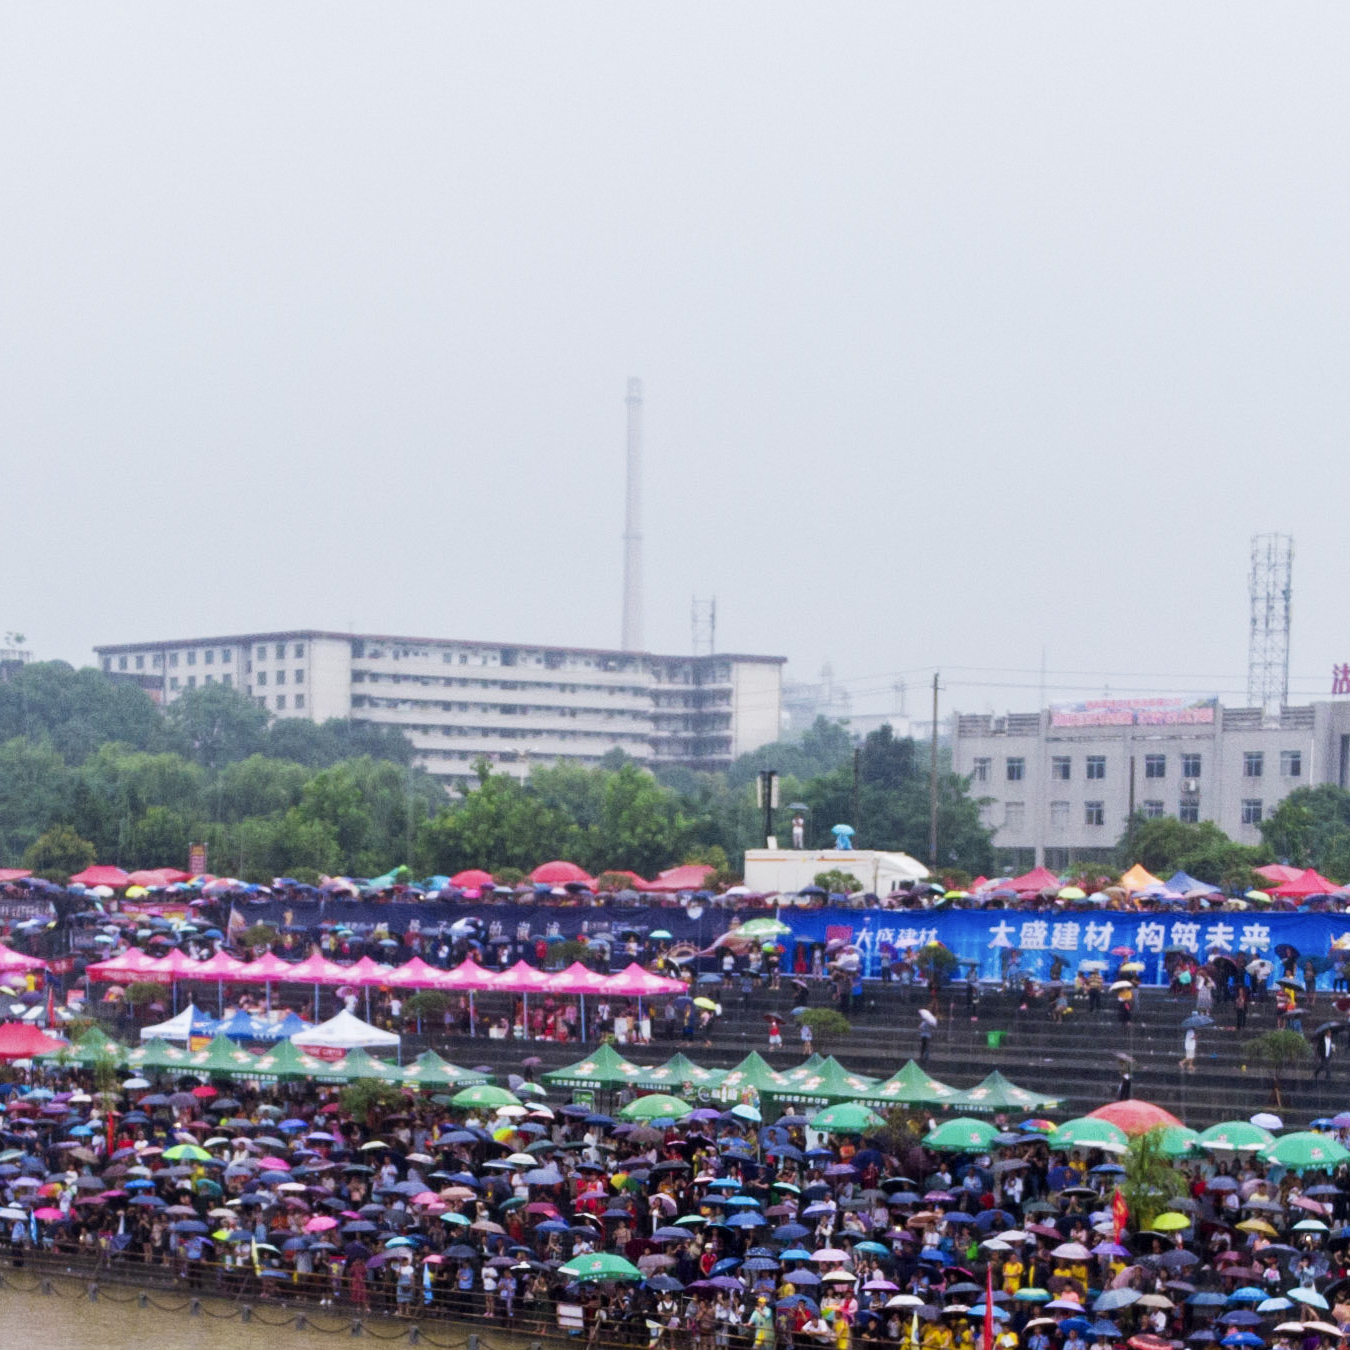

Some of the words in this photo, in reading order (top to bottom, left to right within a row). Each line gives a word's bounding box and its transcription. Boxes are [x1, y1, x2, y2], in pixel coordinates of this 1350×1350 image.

[988, 920, 1114, 951] 大盛建材
[1136, 921, 1271, 953] 构筑未来
